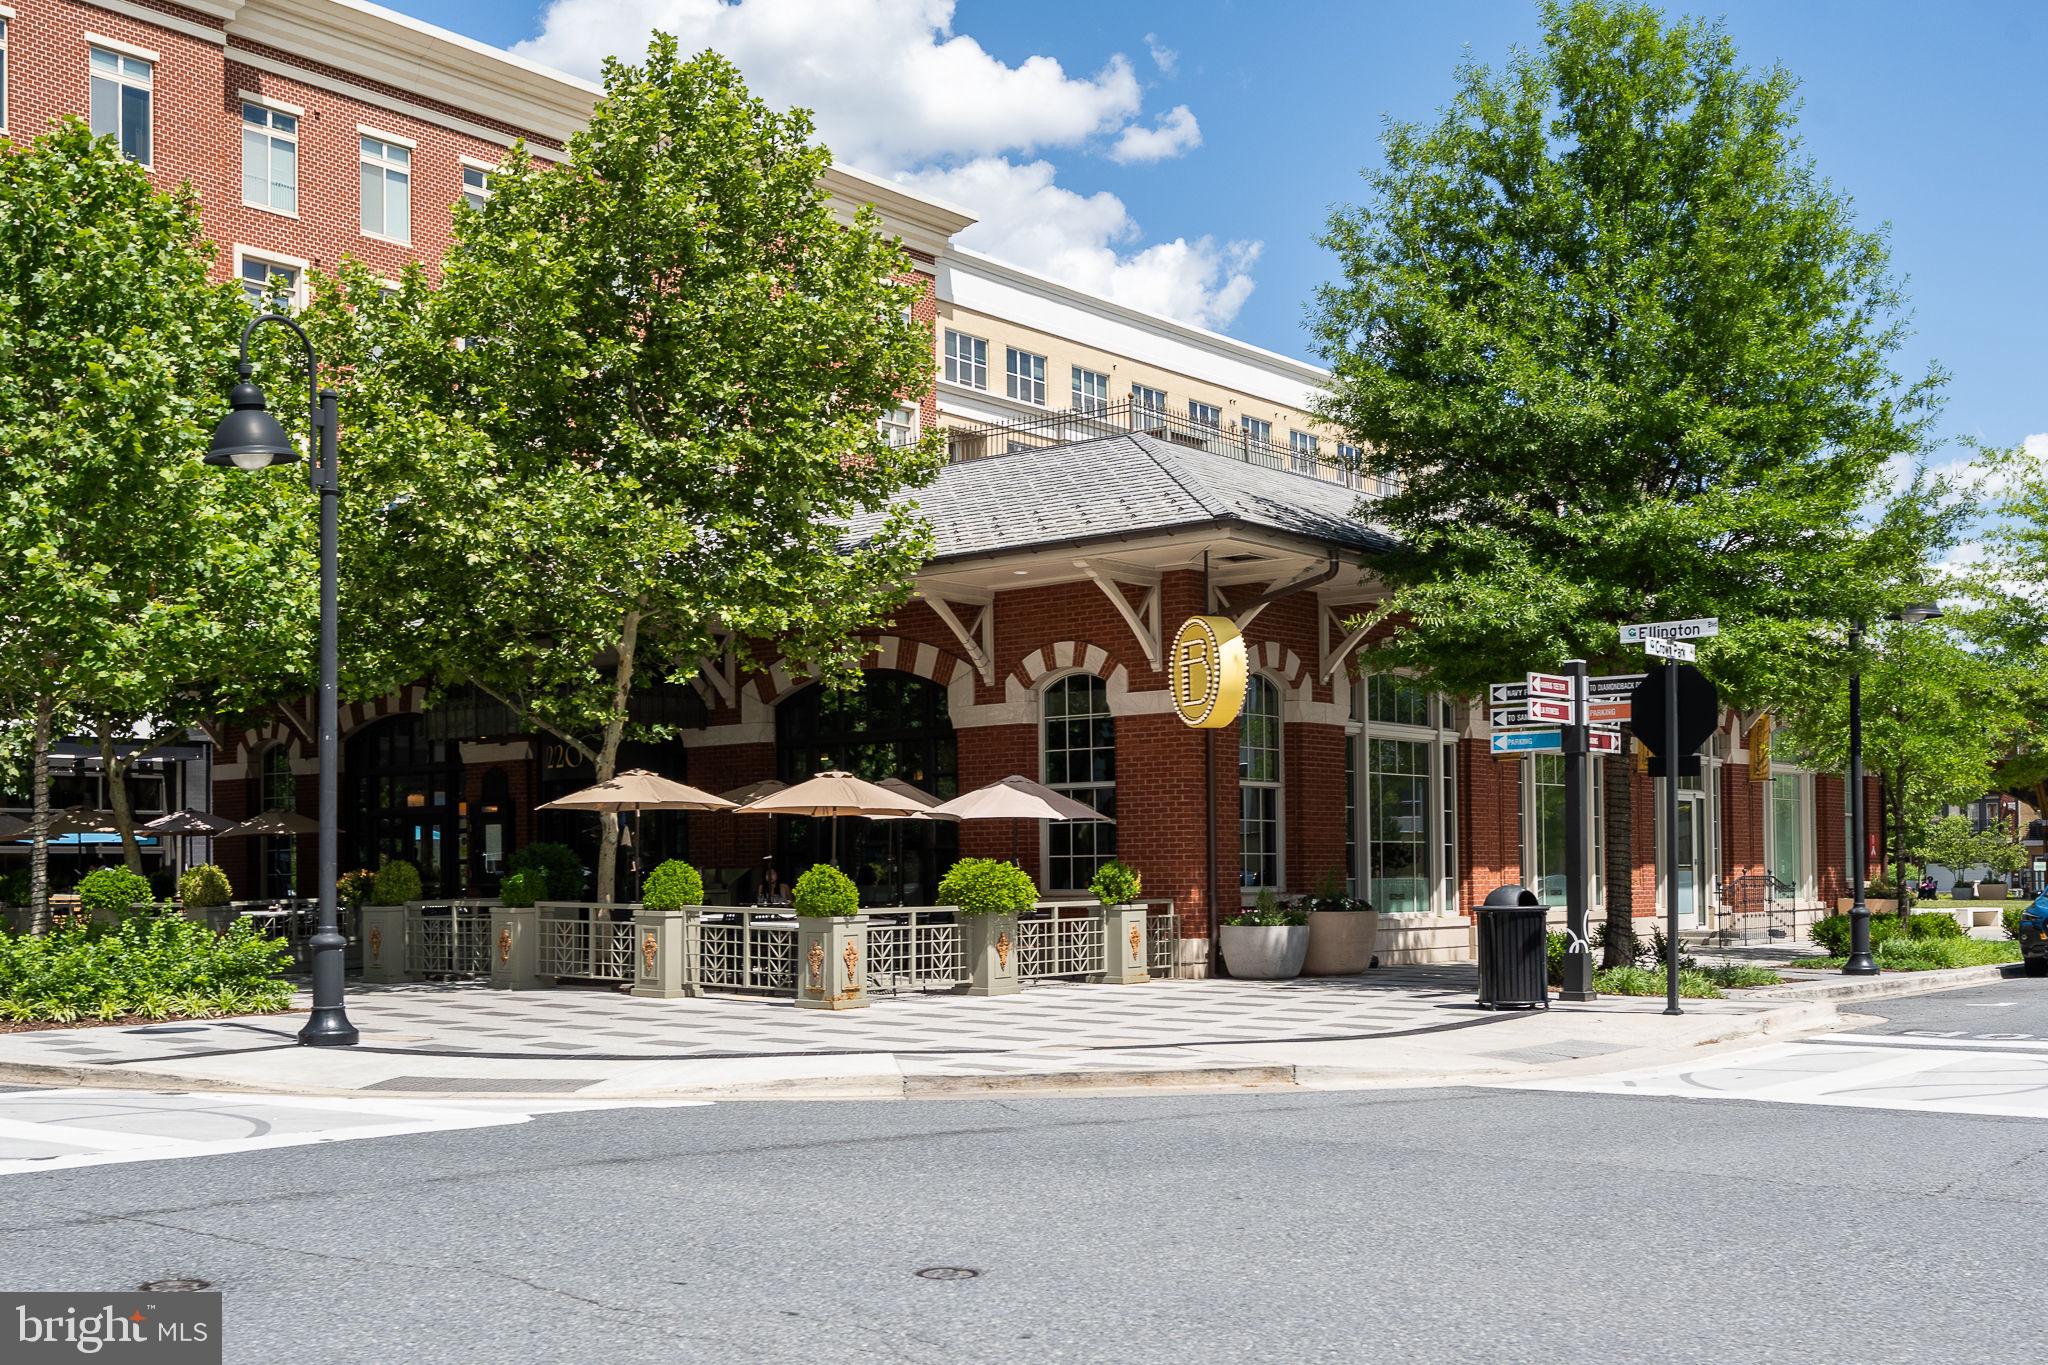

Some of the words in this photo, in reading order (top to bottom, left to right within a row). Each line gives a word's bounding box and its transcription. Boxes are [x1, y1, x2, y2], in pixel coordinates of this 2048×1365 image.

[1639, 624, 1700, 639] Ellington
[1589, 684, 1597, 692] TO
[1507, 689, 1523, 697] NAVY
[1589, 708, 1616, 717] PARKING
[1507, 714, 1516, 722] TO
[1508, 737, 1533, 746] PARKING
